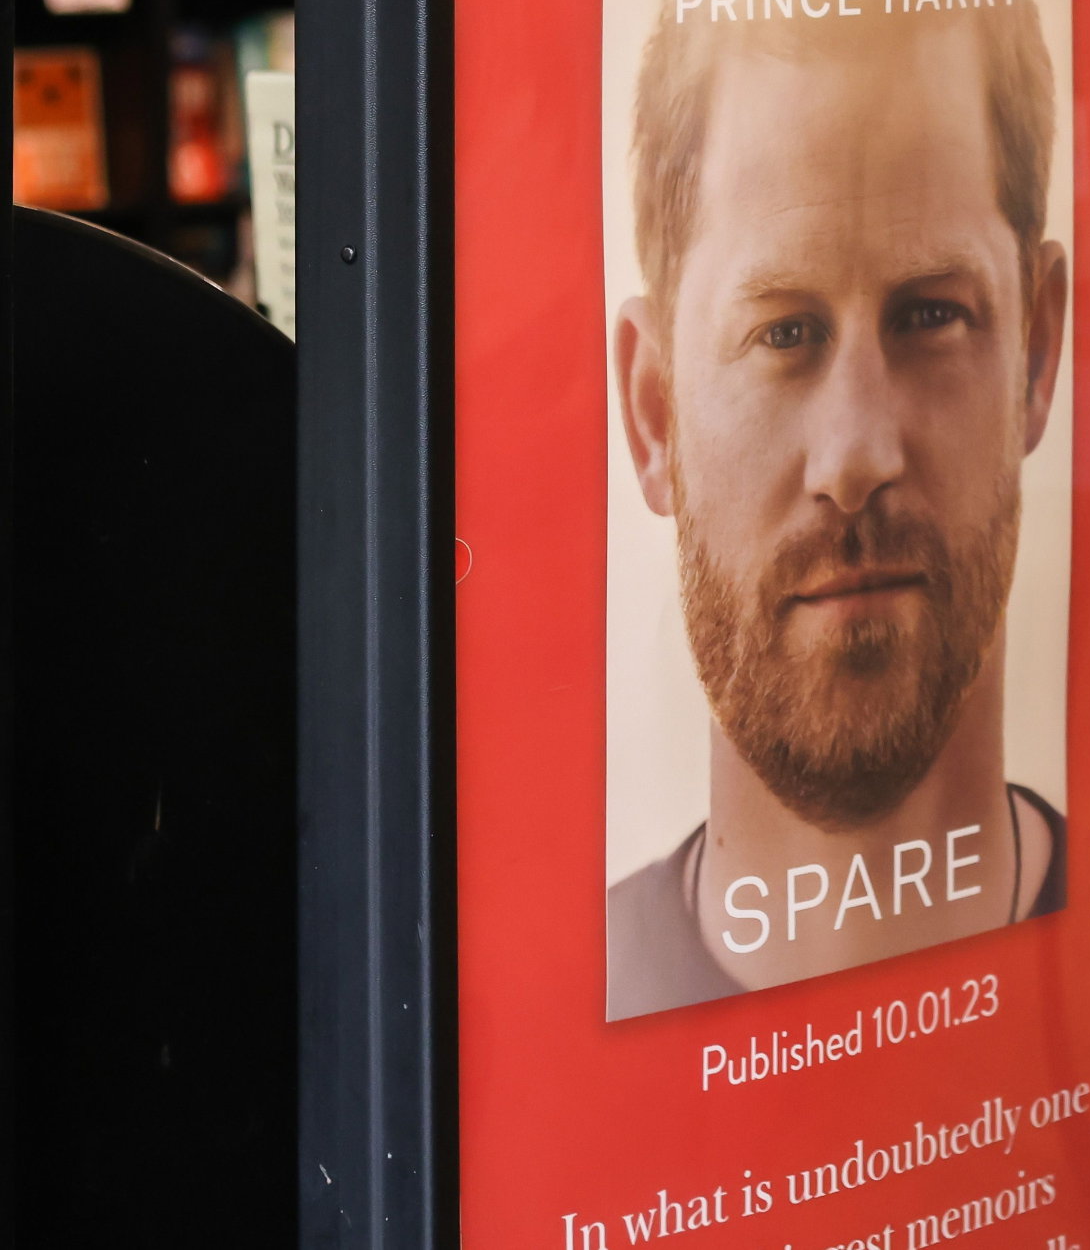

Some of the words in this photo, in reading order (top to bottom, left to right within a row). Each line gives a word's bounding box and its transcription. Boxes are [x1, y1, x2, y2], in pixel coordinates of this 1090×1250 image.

[721, 824, 981, 954] SPARE
[702, 1010, 863, 1091] Published
[872, 974, 1000, 1049] 10.01.23
[561, 1212, 609, 1250] In
[622, 1185, 729, 1246] what
[741, 1169, 773, 1217] is
[786, 1096, 1022, 1206] undoubtedly
[906, 1170, 1056, 1250] memoirs
